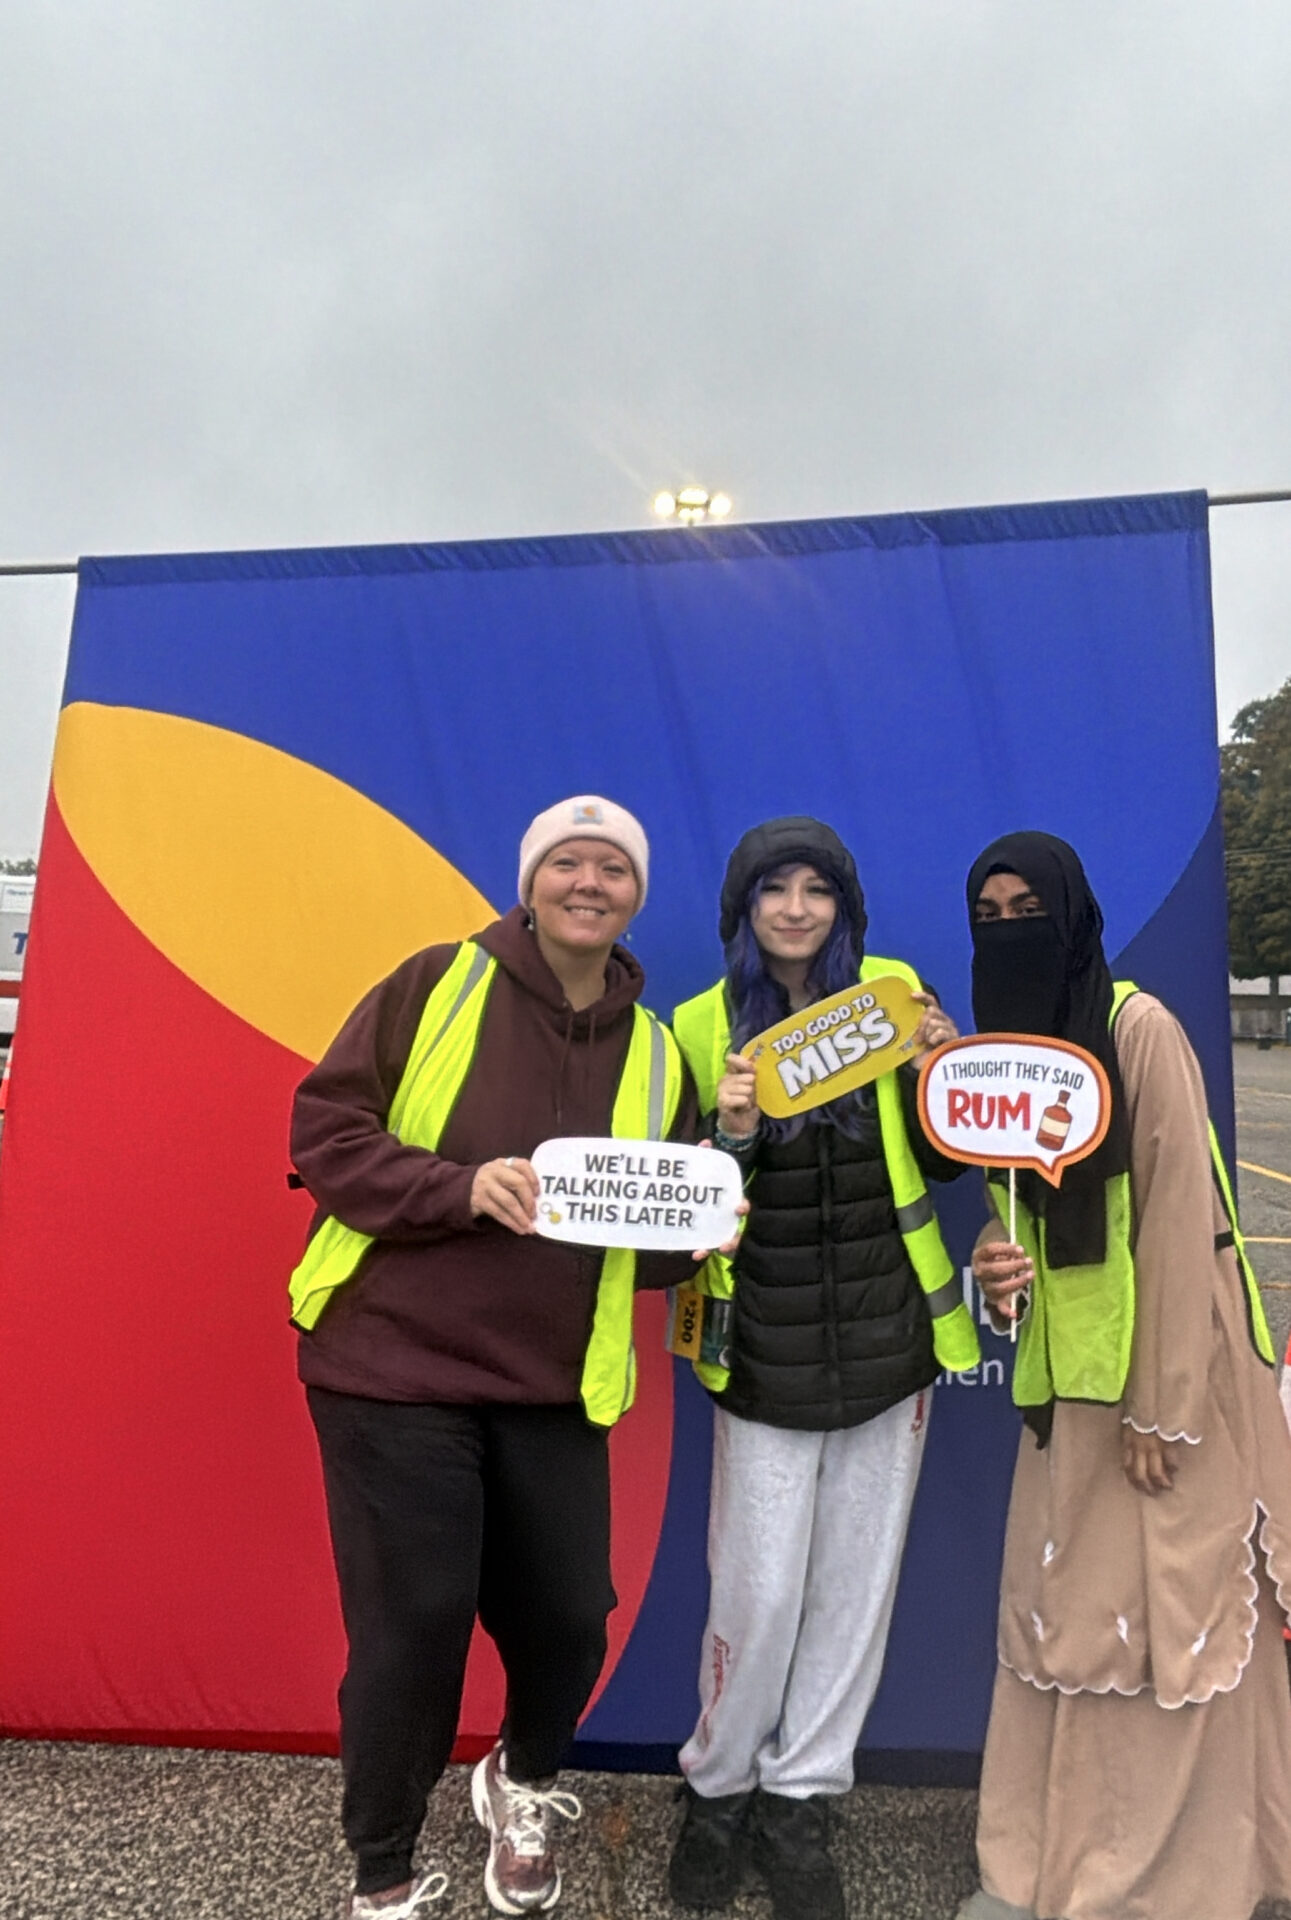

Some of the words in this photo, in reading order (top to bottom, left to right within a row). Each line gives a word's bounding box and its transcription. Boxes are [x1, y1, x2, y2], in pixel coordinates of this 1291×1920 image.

[772, 1029, 804, 1054] TOO
[806, 1005, 851, 1036] GOOD
[852, 993, 875, 1012] TO
[776, 1008, 895, 1098] MISS
[943, 1065, 949, 1080] I
[951, 1061, 1011, 1080] THOUGHT
[1015, 1062, 1050, 1081] THEY
[1052, 1068, 1084, 1090] SAID
[947, 1089, 1031, 1131] RUM
[585, 1154, 650, 1176] WE’LL
[657, 1159, 686, 1178] BE
[542, 1176, 638, 1200] TALKING
[643, 1184, 723, 1205] ABOUT
[566, 1202, 617, 1222] THIS
[624, 1206, 693, 1227] LATER
